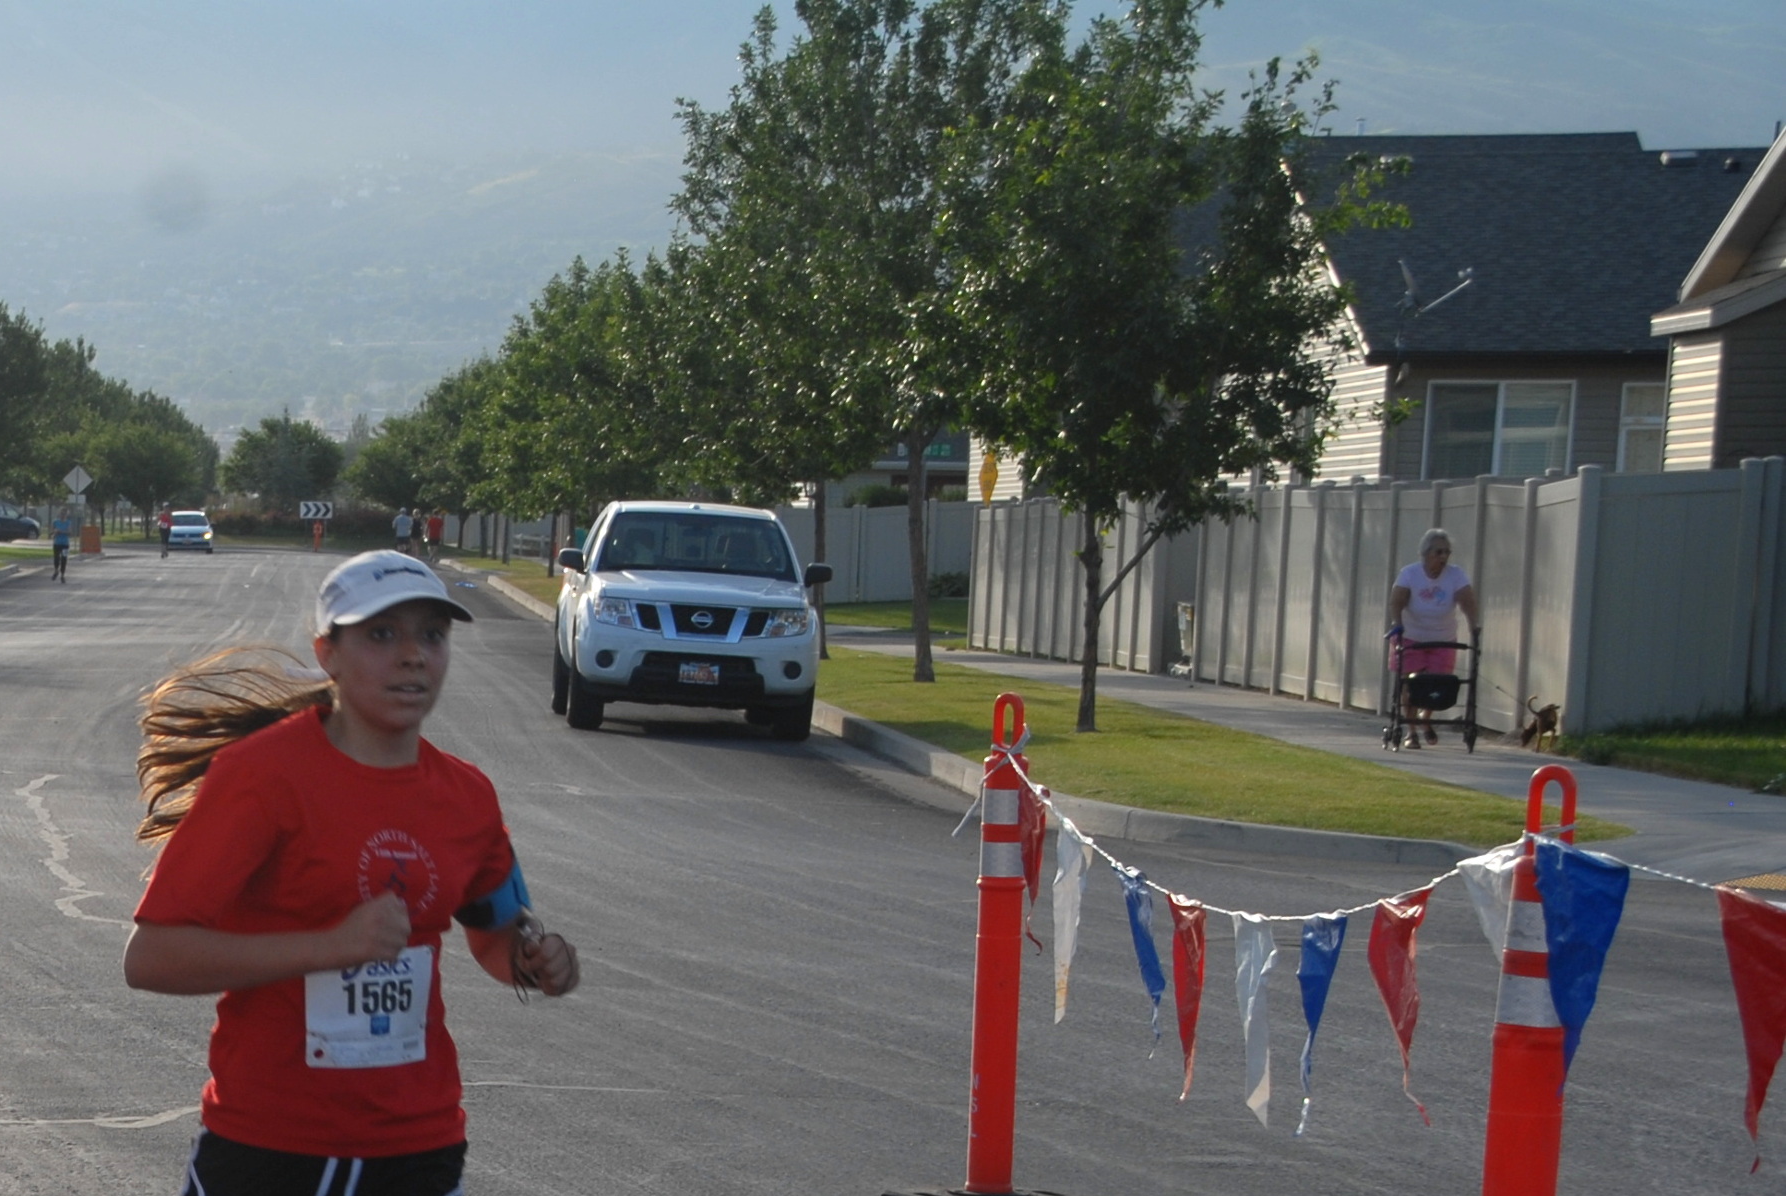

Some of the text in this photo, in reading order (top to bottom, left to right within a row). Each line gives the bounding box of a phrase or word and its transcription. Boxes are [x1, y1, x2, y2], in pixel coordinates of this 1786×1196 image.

[358, 848, 371, 871] OF
[366, 829, 409, 850] NORTH
[342, 979, 413, 1016] 1565
